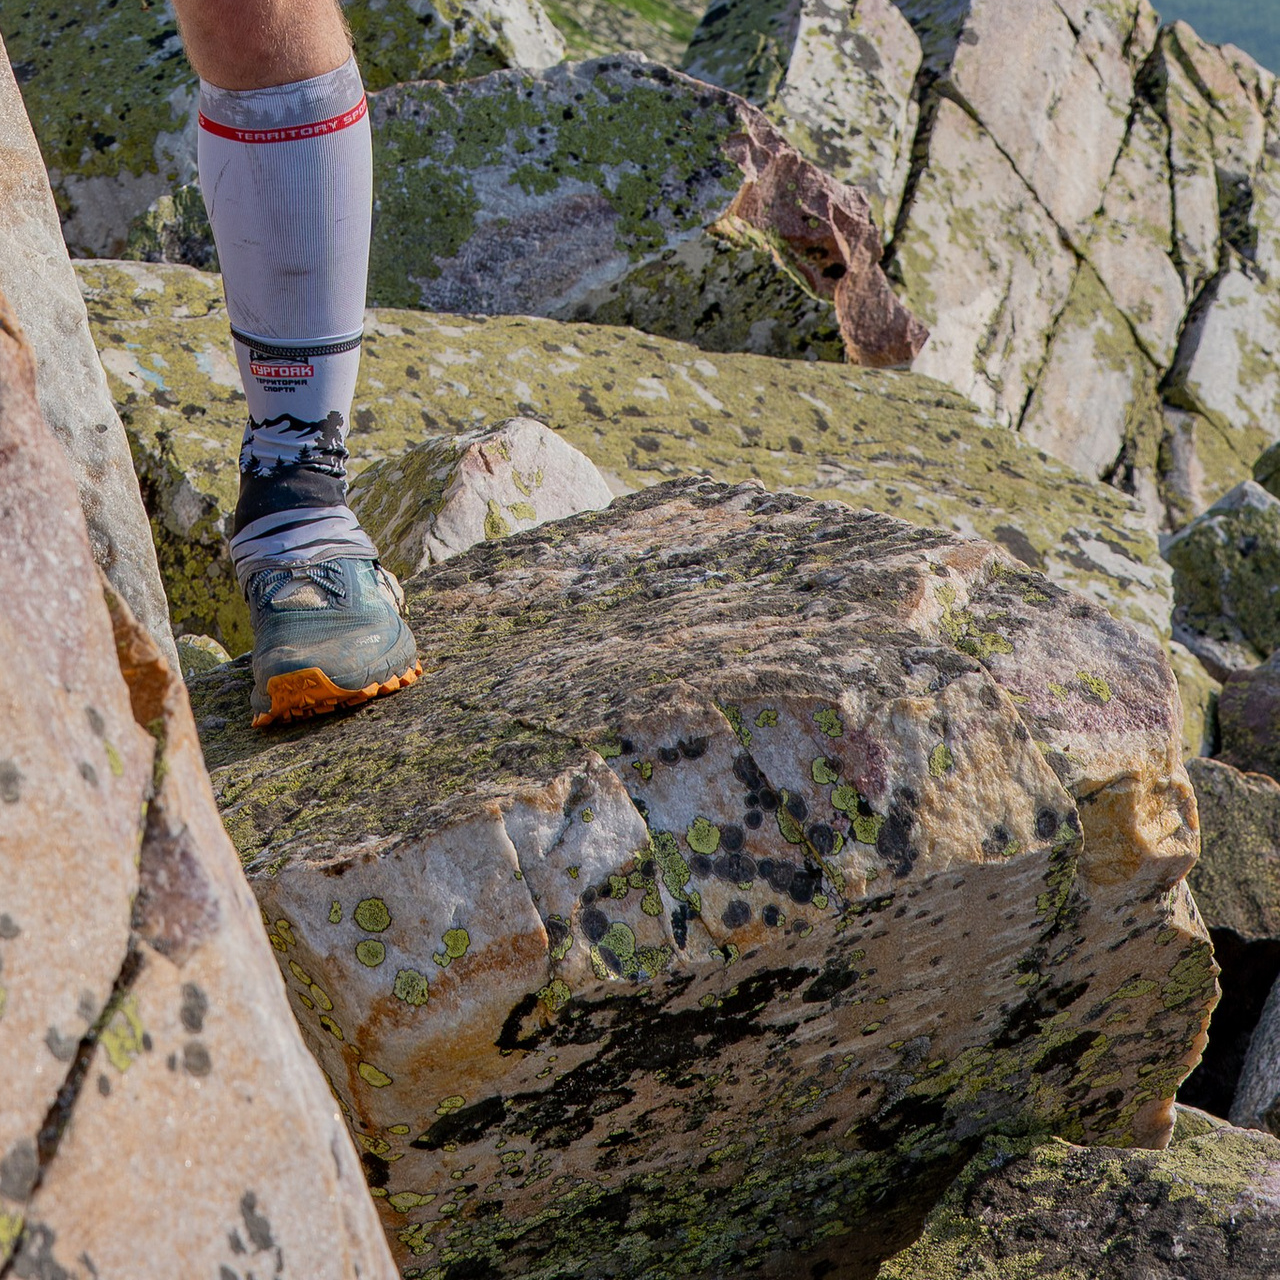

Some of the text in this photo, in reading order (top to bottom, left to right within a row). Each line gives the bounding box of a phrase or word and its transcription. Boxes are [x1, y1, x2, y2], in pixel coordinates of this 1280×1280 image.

[235, 120, 337, 140] TERRITORY
[251, 365, 312, 376] ТУРГОЯК
[256, 378, 308, 386] ТЕРРИТОРИЯ
